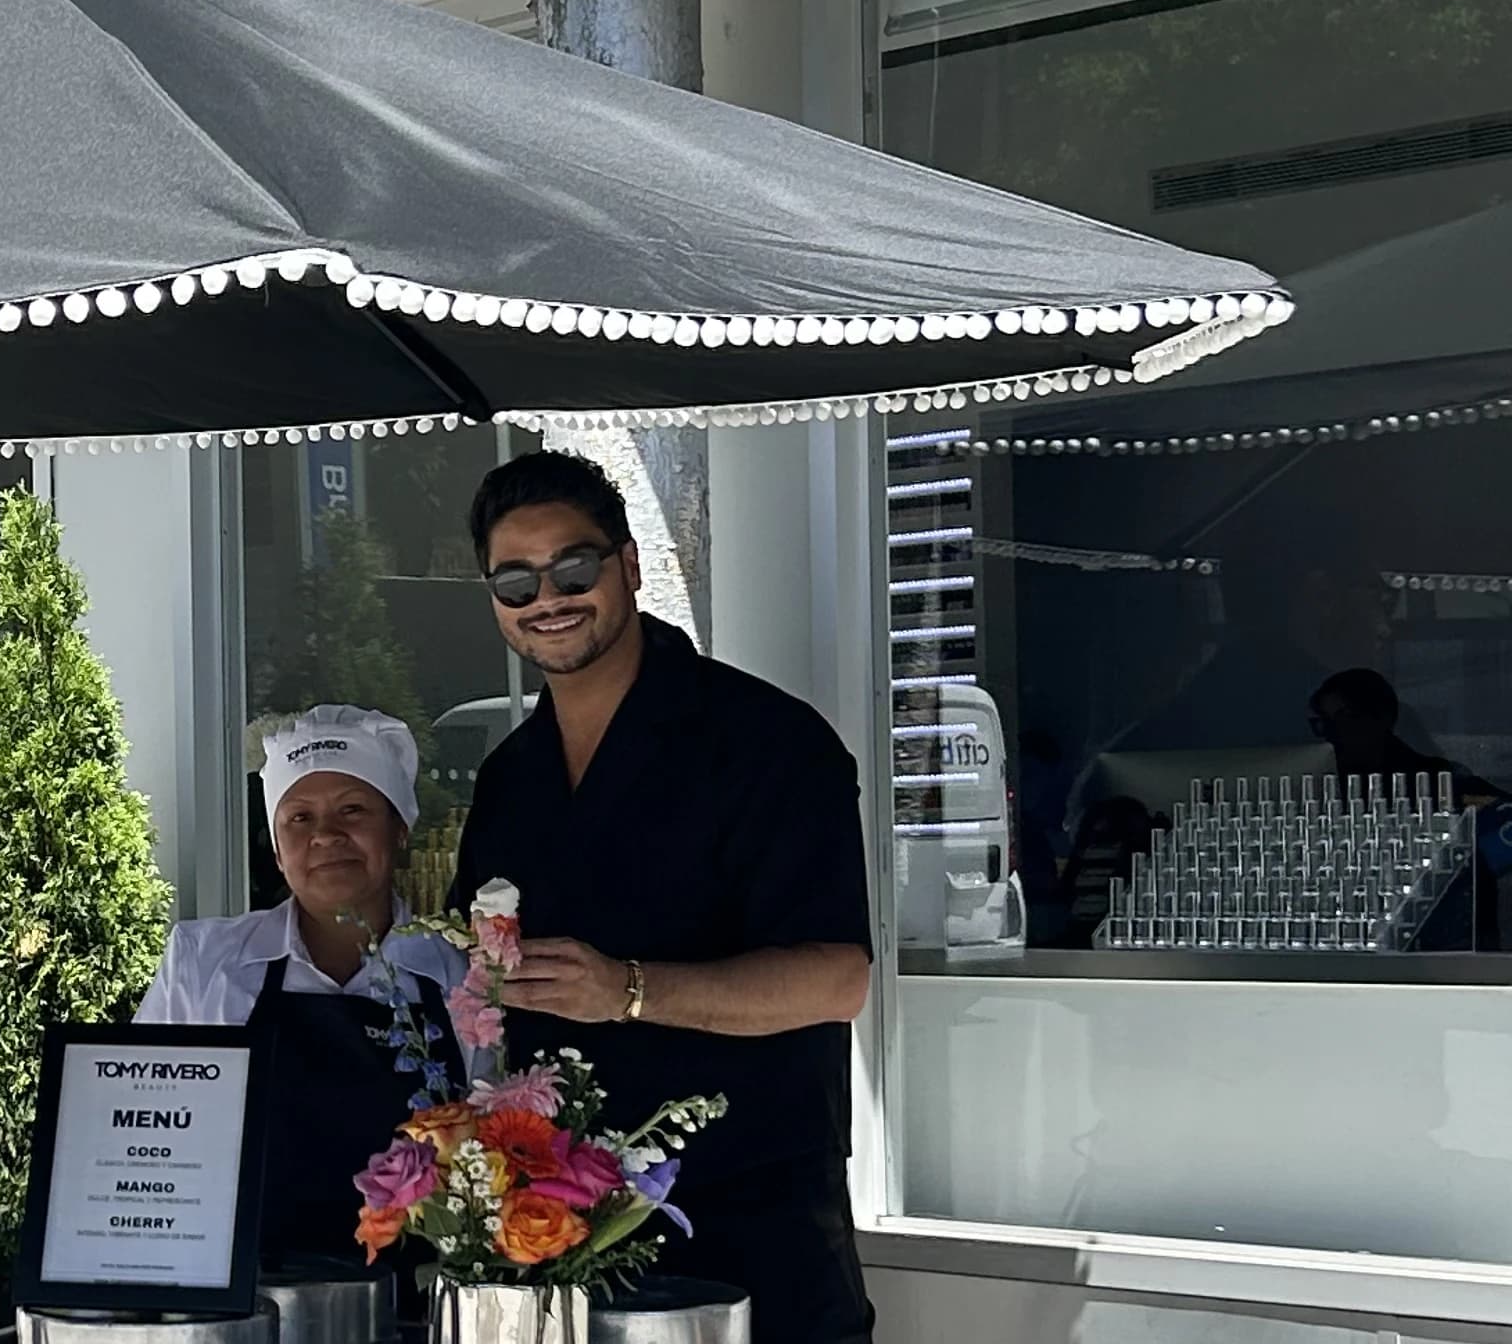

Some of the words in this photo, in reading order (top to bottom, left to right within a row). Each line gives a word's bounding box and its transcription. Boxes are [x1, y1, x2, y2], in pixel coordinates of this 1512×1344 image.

[94, 1060, 150, 1079] TOMY
[151, 1062, 221, 1082] RIVERO
[112, 1105, 192, 1130] MENÚ
[126, 1145, 172, 1159] COCO
[115, 1180, 176, 1194] MANGO
[109, 1215, 176, 1230] CHERRY
